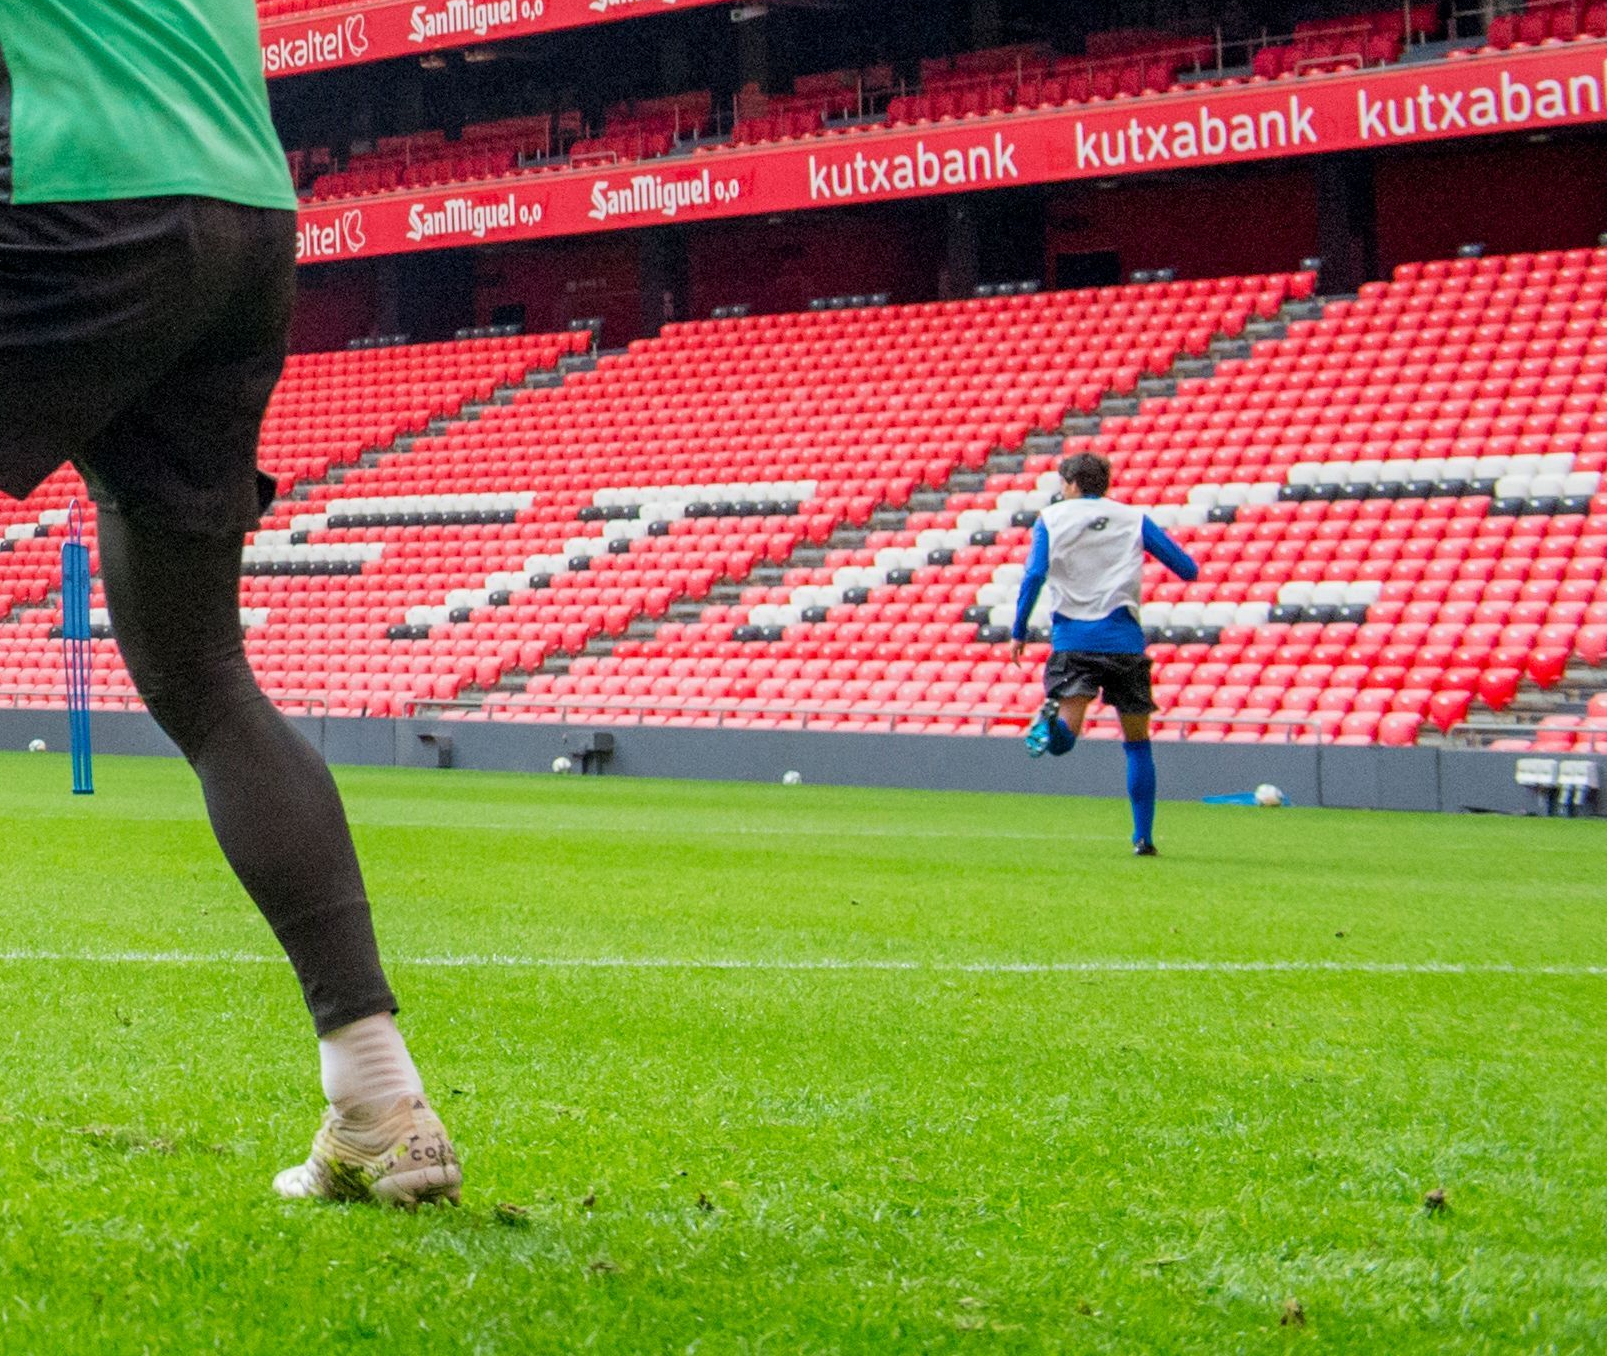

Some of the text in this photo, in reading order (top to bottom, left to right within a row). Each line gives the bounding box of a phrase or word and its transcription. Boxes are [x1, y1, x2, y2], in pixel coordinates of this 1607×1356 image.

[522, 0, 543, 20] 0,0
[1359, 59, 1607, 138] kutxaban
[1076, 95, 1316, 168] kutxabank
[807, 133, 1017, 199] kutxabank
[715, 180, 738, 202] 0,0
[520, 204, 541, 225] 0,0
